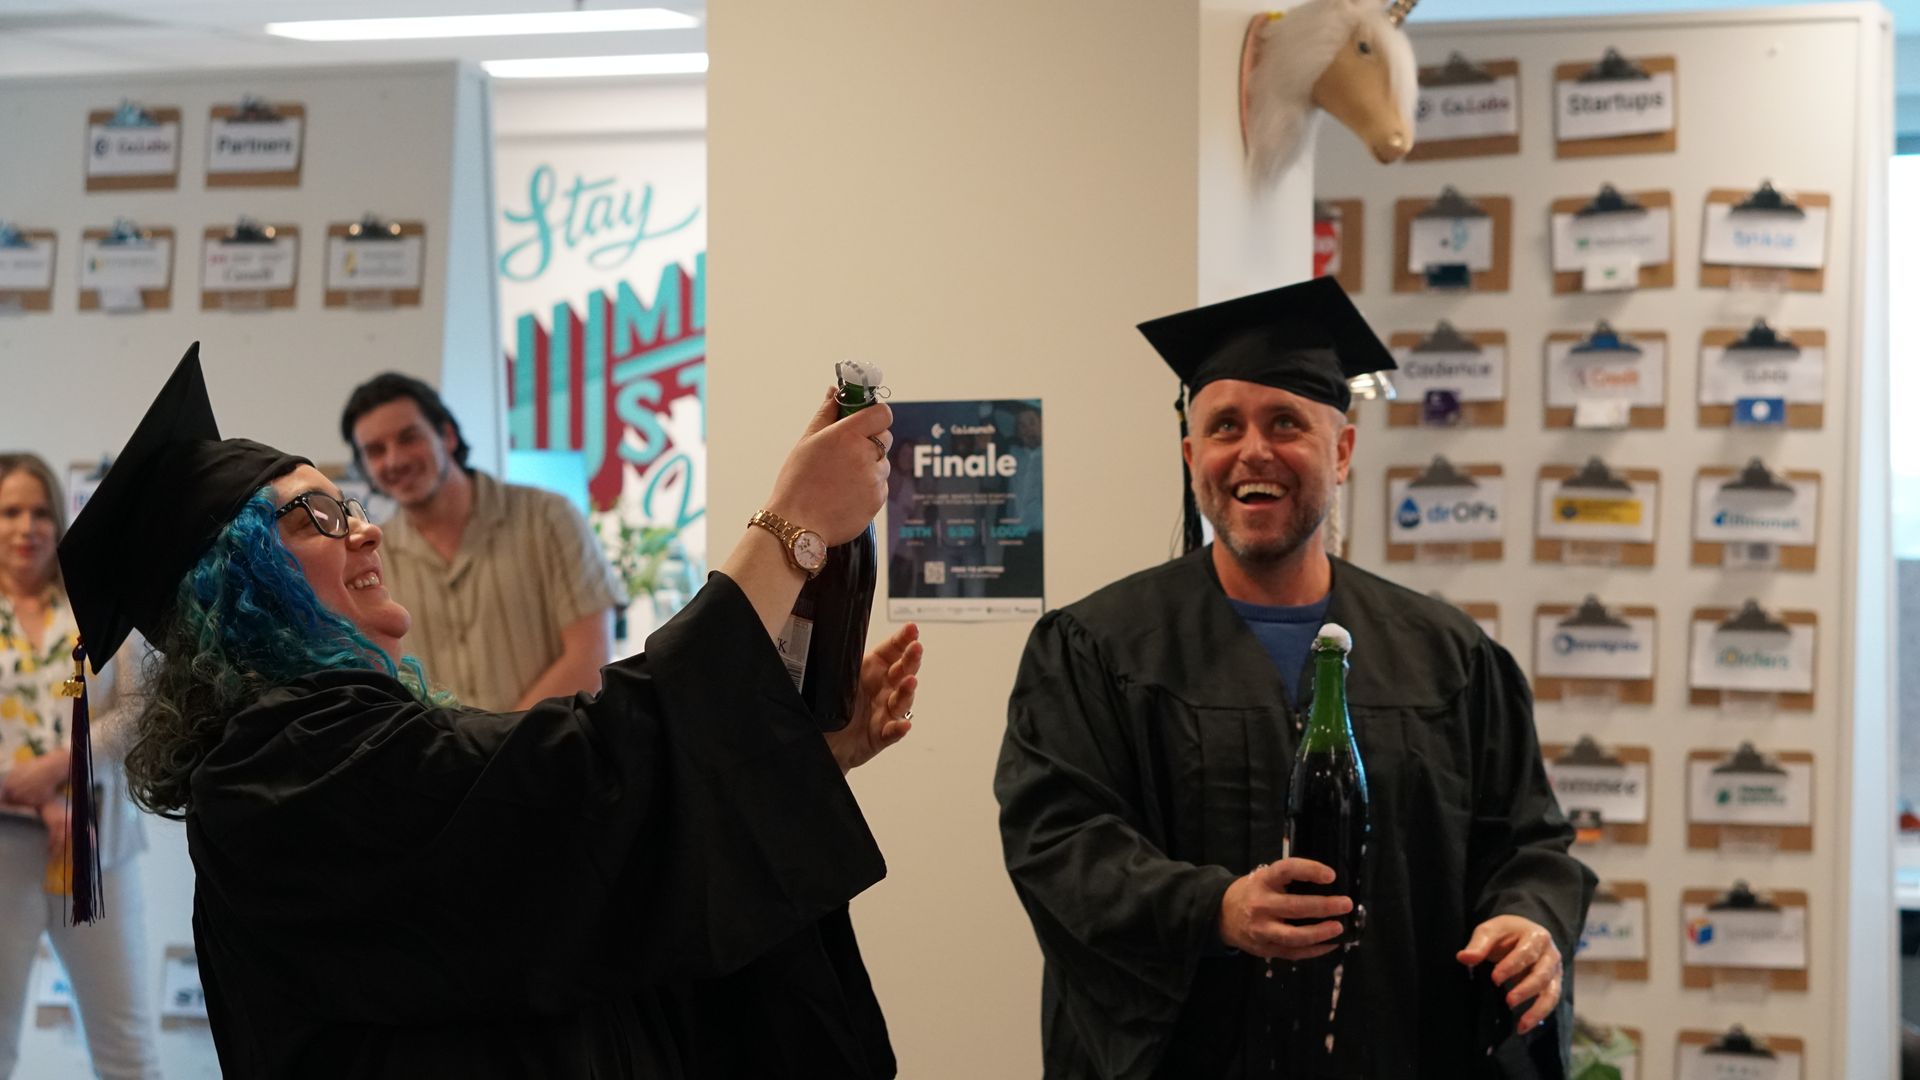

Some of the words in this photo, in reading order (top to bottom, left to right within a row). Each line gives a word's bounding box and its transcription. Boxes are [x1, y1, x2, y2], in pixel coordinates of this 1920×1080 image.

[1566, 90, 1663, 116] Startups
[217, 137, 292, 155] Partners
[498, 163, 700, 283] Stay
[913, 442, 1018, 479] Finale
[1426, 502, 1498, 524] drOPs
